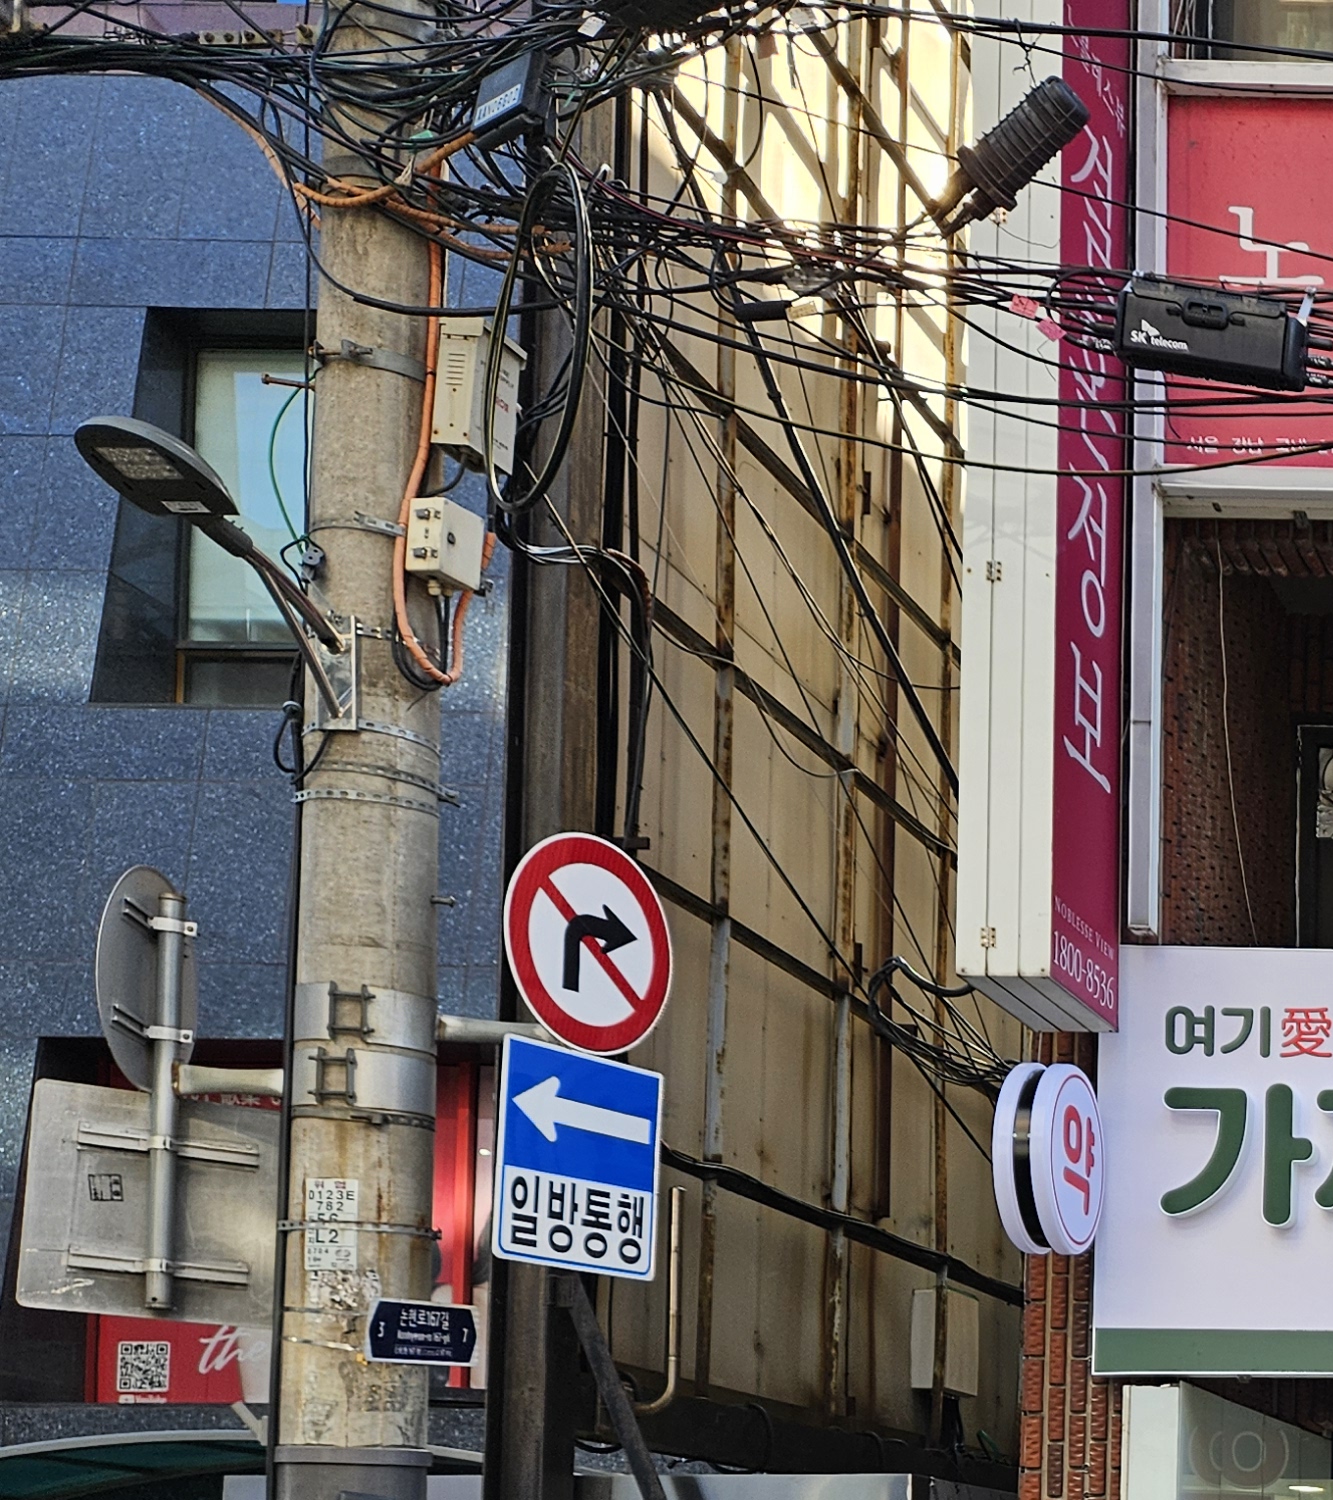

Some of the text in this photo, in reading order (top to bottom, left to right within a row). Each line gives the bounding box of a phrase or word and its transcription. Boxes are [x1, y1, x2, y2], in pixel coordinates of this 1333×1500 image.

[1130, 330, 1188, 351] SK telecom
[1055, 895, 1093, 943] NOBLESSE
[1053, 930, 1114, 1010] 1800-8536
[1062, 1113, 1096, 1218] 약
[510, 1175, 645, 1265] 일방통행
[377, 1321, 385, 1338] 3
